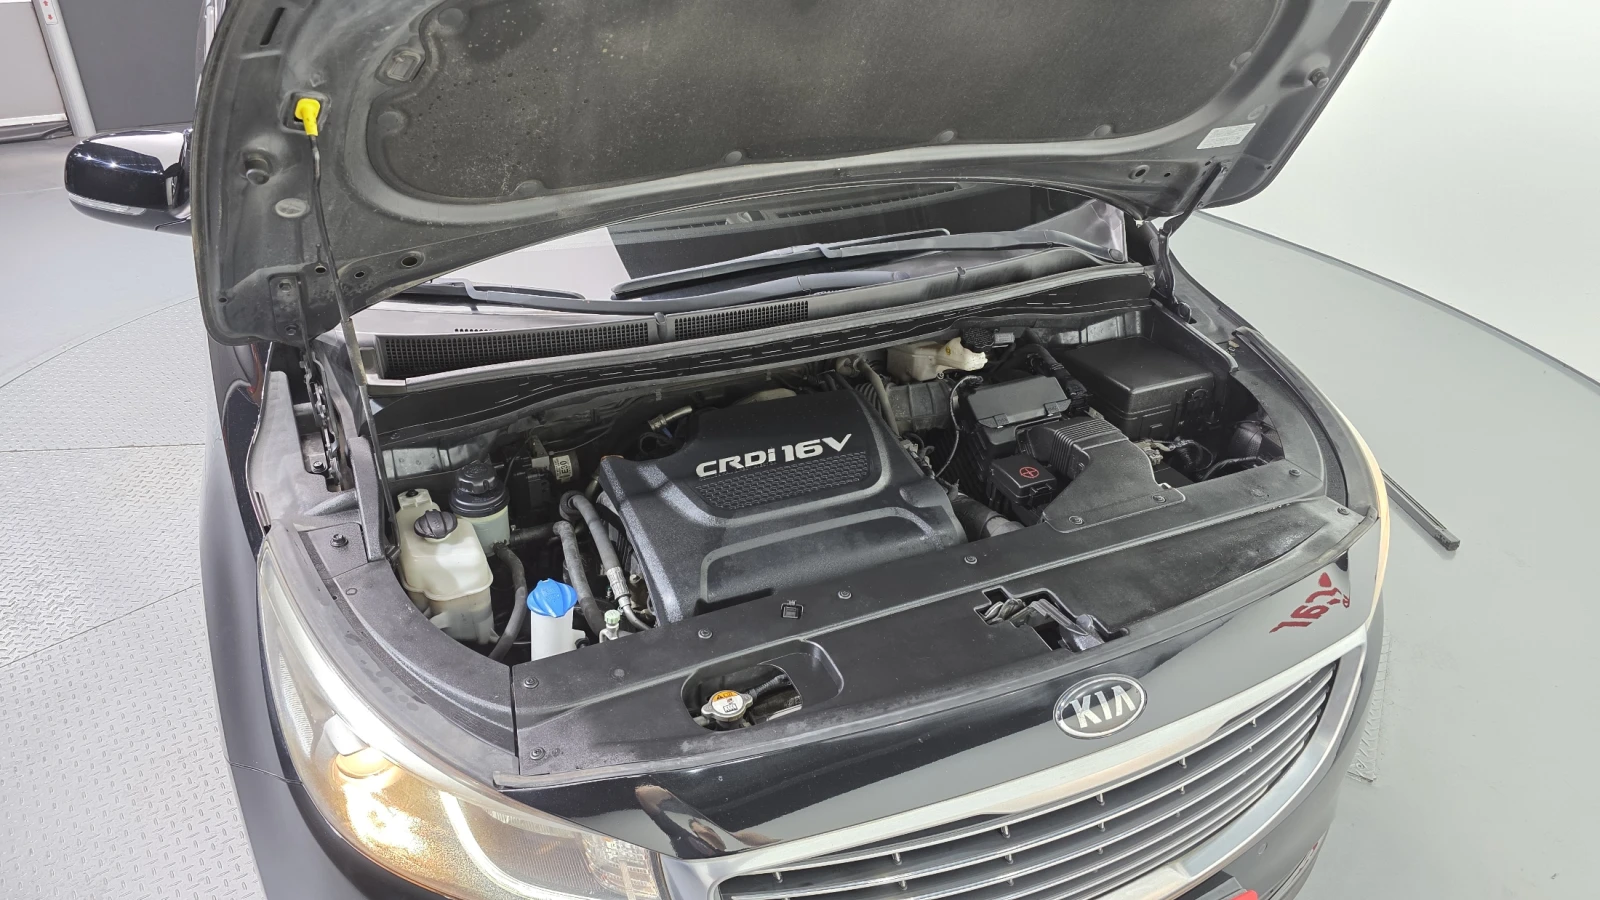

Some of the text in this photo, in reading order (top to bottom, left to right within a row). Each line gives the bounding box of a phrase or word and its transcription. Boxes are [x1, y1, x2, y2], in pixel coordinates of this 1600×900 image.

[695, 433, 852, 478] CRDi 16V
[1069, 685, 1136, 729] KIA
